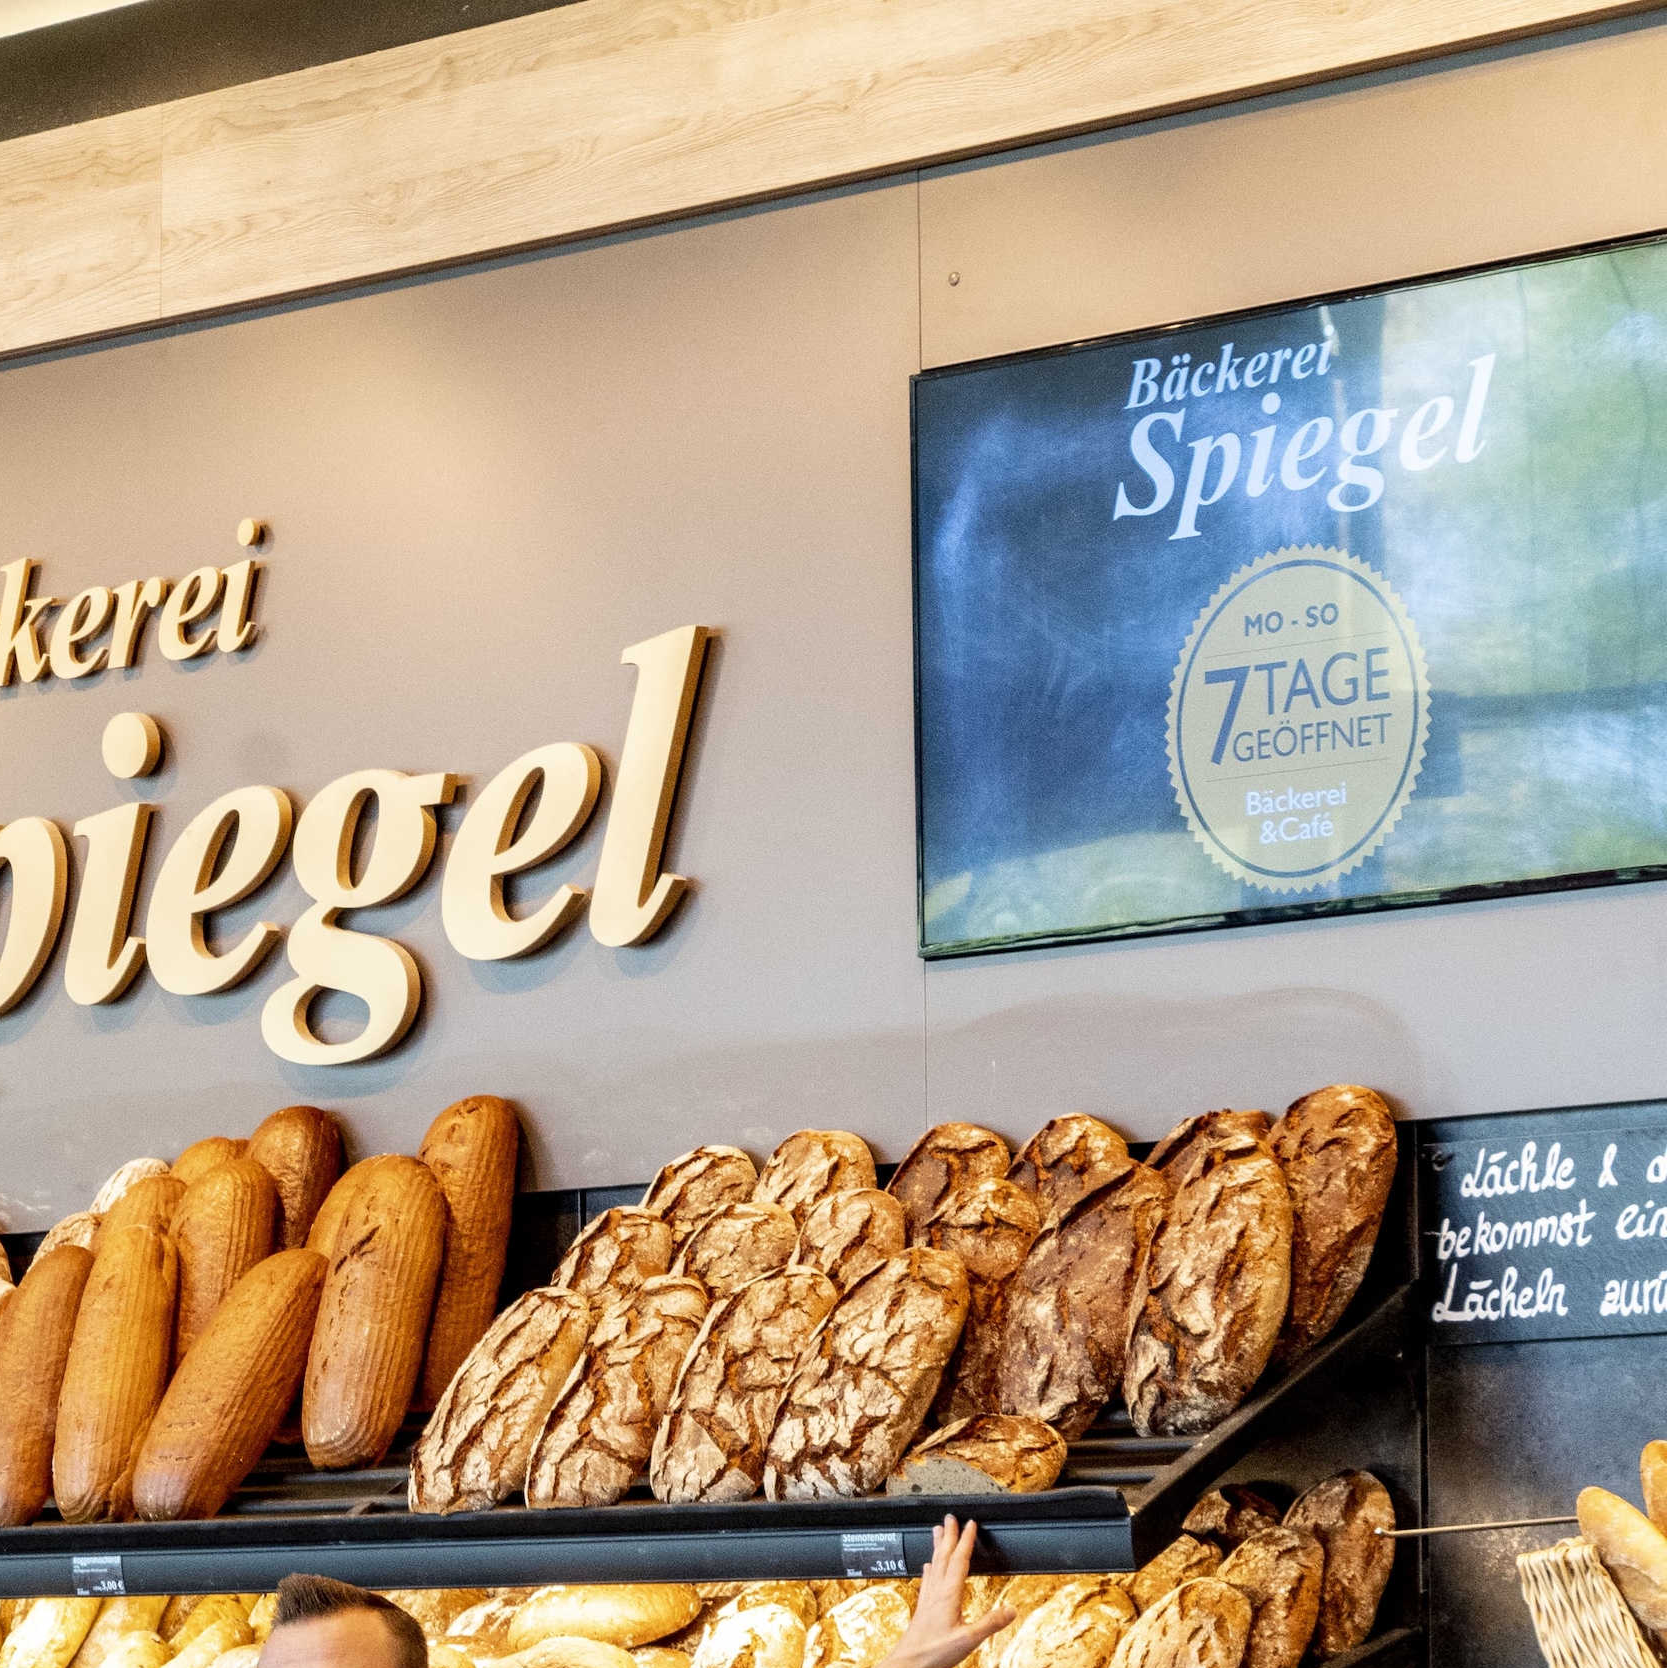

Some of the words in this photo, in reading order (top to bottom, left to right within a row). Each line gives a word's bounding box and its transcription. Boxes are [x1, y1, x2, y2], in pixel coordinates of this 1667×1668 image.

[1124, 324, 1335, 409] Bäckerei
[1112, 353, 1497, 541] Spiegel
[1244, 612, 1282, 638] MO
[1306, 602, 1340, 629] SO
[1203, 667, 1252, 766] 7
[1254, 646, 1392, 717] TAGE
[1232, 713, 1393, 765] GEÖFFNET
[1246, 783, 1348, 817] Bäckerei
[1460, 1141, 1576, 1198] Lächle
[1437, 1198, 1596, 1261] bekommst
[1432, 1262, 1569, 1323] Lächeln
[876, 1560, 896, 1572] 3,10
